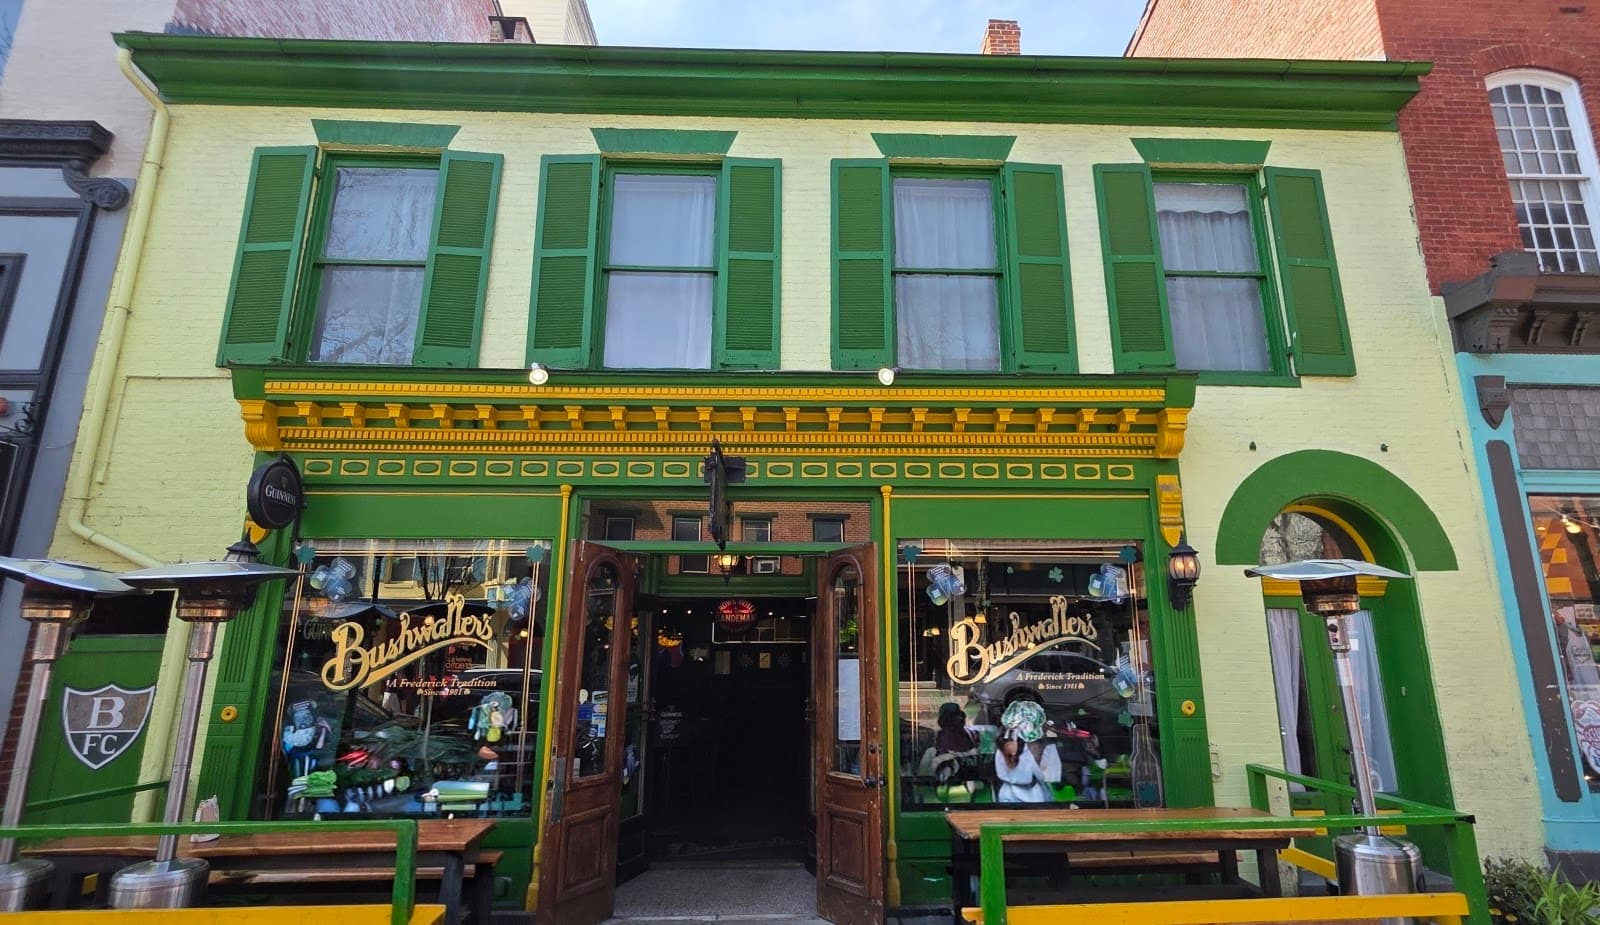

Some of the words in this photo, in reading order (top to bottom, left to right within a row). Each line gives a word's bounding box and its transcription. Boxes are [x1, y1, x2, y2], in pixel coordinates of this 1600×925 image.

[265, 484, 296, 505] GUINNESS
[321, 594, 495, 690] Bushwaller's
[947, 595, 1097, 685] Bushwaller's
[389, 679, 397, 688] A
[399, 678, 448, 688] Frederick
[450, 678, 497, 688] Tradition
[1015, 672, 1023, 681] A
[1025, 672, 1065, 681] Frederick
[1066, 672, 1105, 681] Tradition
[86, 696, 125, 729] B
[82, 733, 118, 756] FC
